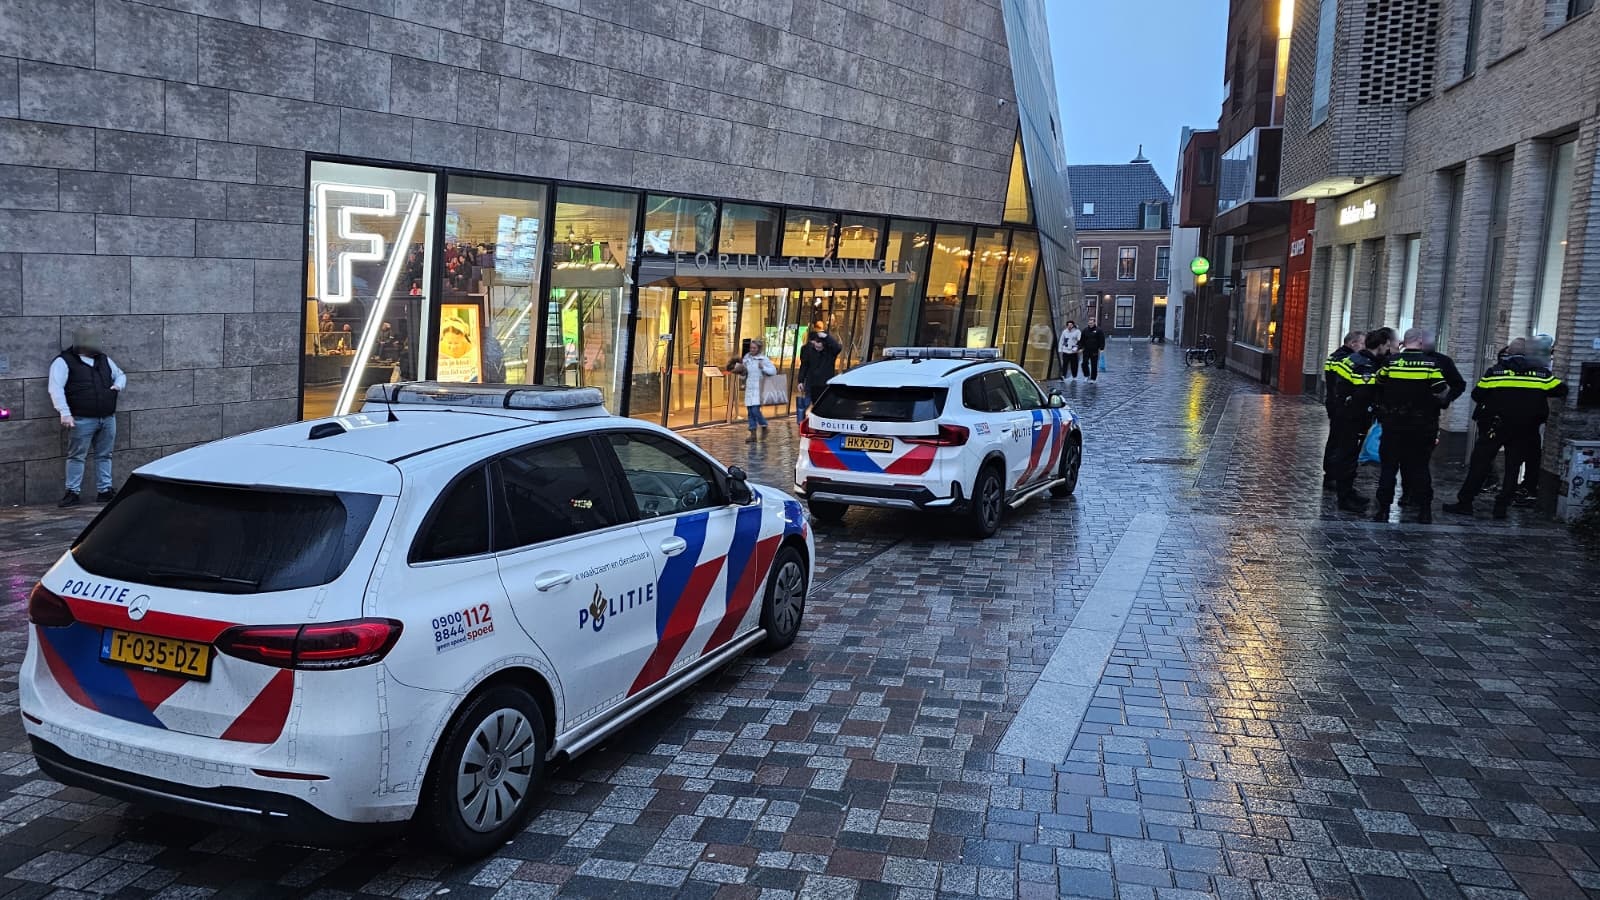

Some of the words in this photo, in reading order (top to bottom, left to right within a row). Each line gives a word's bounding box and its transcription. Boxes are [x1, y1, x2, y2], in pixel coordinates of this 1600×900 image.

[675, 252, 770, 276] FORUM
[788, 256, 913, 273] GRONINGEN
[821, 421, 855, 431] POLITIE
[847, 436, 890, 449] HKX-70-D
[62, 579, 130, 603] POLITIE
[463, 603, 491, 627] 112
[579, 582, 653, 632] POLITIE
[432, 611, 462, 630] 0900
[467, 622, 493, 640] spoed
[435, 624, 464, 642] 8844
[117, 634, 200, 671] T-035-DZ
